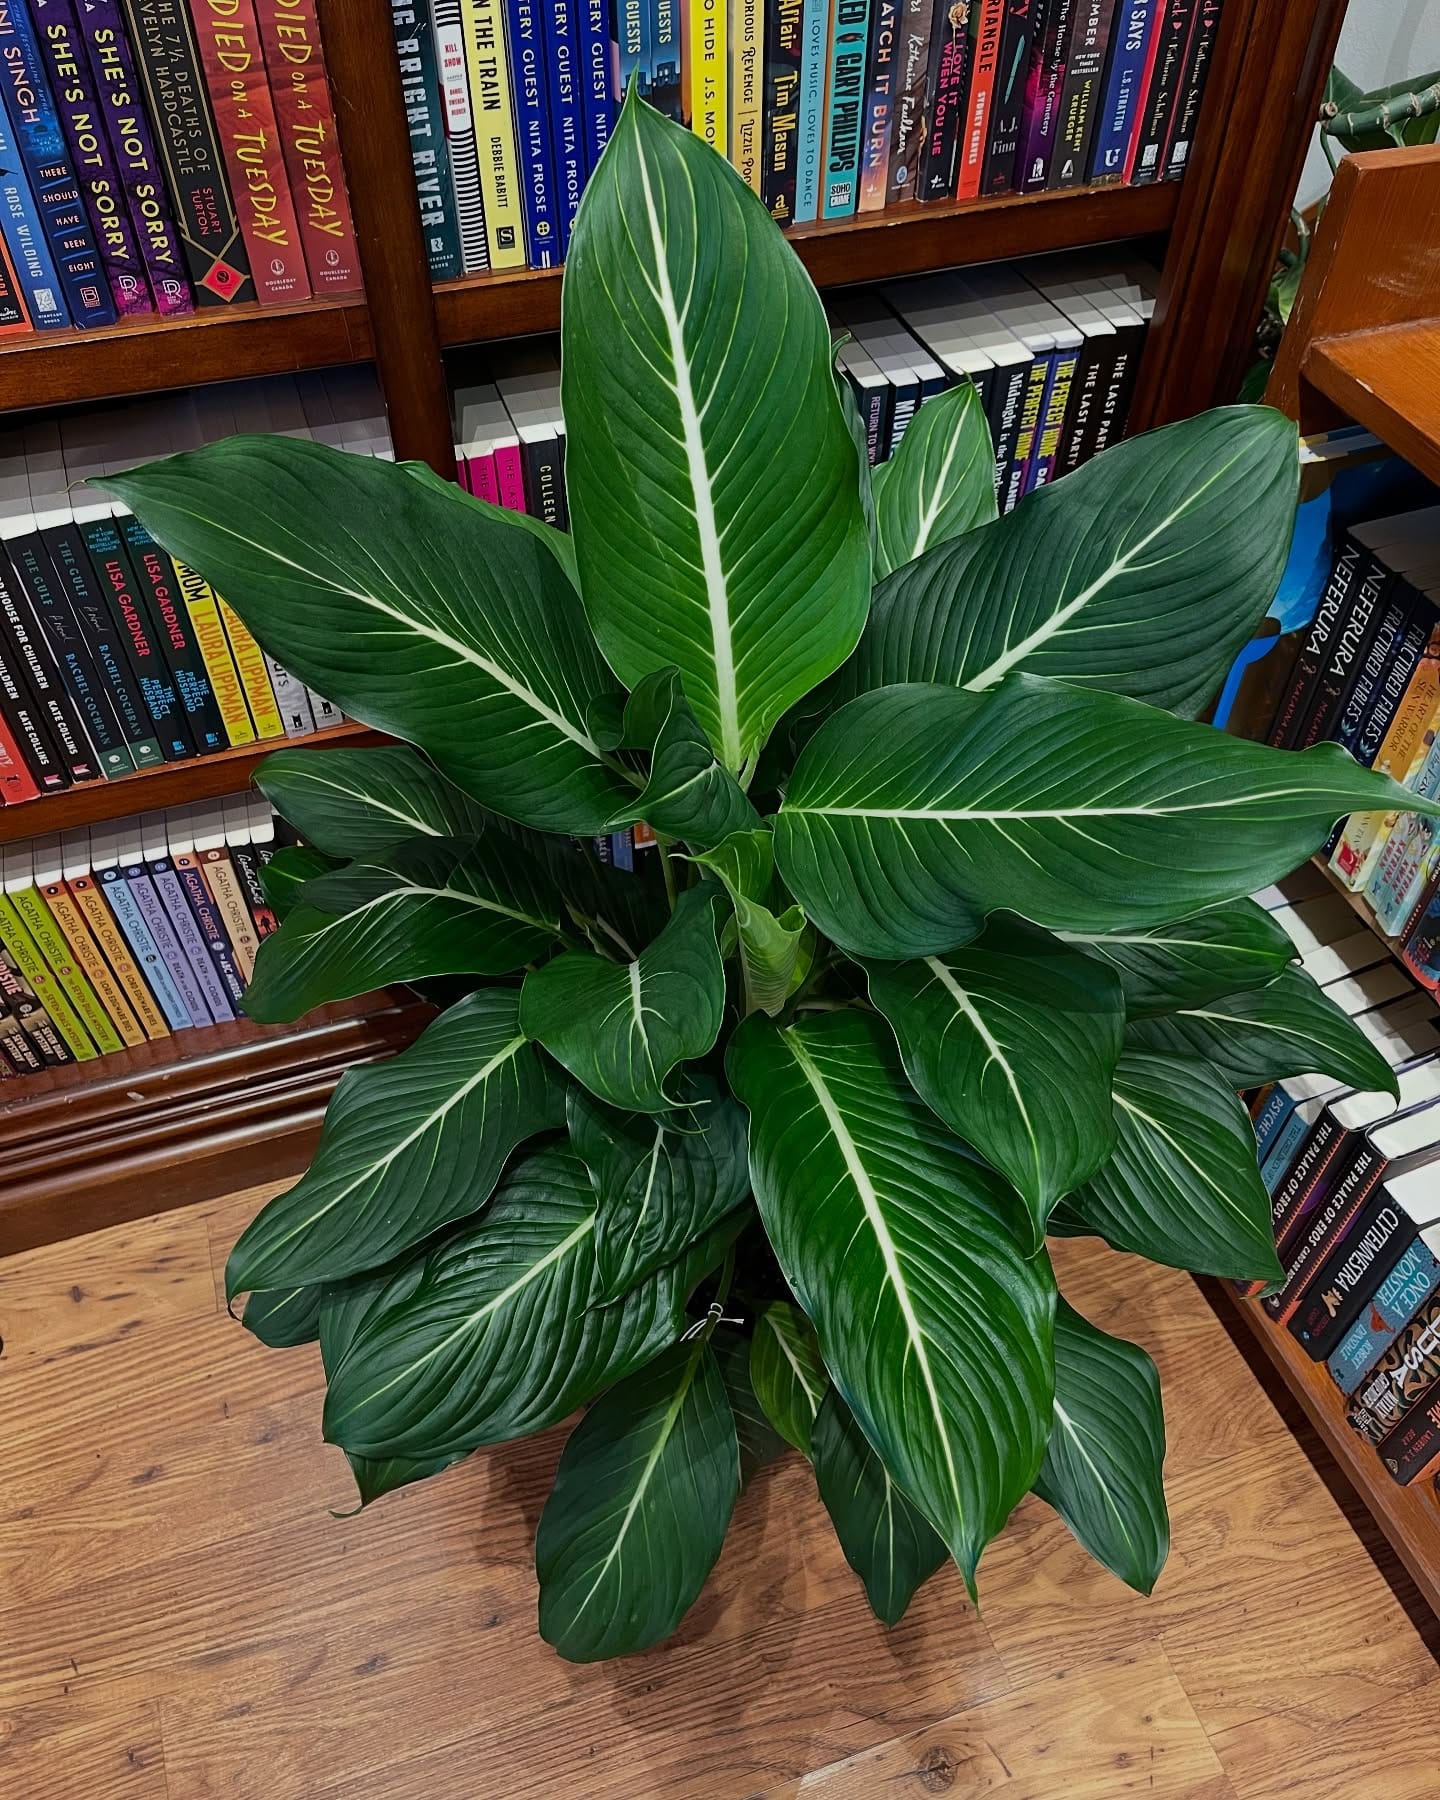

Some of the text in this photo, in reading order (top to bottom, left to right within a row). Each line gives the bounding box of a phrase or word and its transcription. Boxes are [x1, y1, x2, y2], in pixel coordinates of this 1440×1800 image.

[626, 0, 641, 54] GUESTS
[778, 0, 802, 49] Affair
[1060, 0, 1070, 21] The
[1125, 9, 1147, 51] SAYS
[444, 57, 462, 68] SHOW
[704, 18, 715, 105] HIDE J.S.
[905, 34, 925, 91] Katherine
[1054, 25, 1066, 57] House
[4, 46, 41, 123] SINGH
[397, 39, 432, 137] BRIGHT
[479, 57, 501, 111] TRAIN
[591, 42, 607, 150] GUEST NITA
[742, 47, 755, 103] REVENGE
[774, 71, 798, 107] Tim
[834, 53, 862, 101] GARY
[932, 42, 953, 156] WHEN YOU LIE
[949, 44, 964, 106] LOVE IT
[1049, 74, 1058, 89] the
[156, 66, 193, 175] HARDCASTLE
[175, 71, 201, 138] DEATHS
[207, 0, 289, 246] DIED ON A TUESDAY
[522, 49, 547, 213] GUEST NITA PROSE
[557, 45, 579, 209] GUEST NITA PROSE
[803, 19, 820, 207] LOVES LOVES TO DANCE
[869, 74, 889, 168] IT BURN
[897, 96, 915, 155] Faulkner
[1040, 90, 1056, 136] Cemetery
[1065, 95, 1079, 141] KRUEGER
[1073, 80, 1092, 152] WILLIAM KENT
[1112, 88, 1130, 132] STRATTON
[47, 24, 84, 103] SHE'S
[71, 113, 104, 167] NOT
[91, 180, 130, 260] SORRY
[95, 29, 131, 107] SHE'S
[118, 118, 148, 171] NOT
[136, 184, 174, 264] SORRY
[291, 72, 345, 237] ON A TUESDAY
[740, 119, 754, 154] LIZZIE
[772, 113, 796, 172] Mason
[829, 100, 859, 173] PHILLIPS
[991, 141, 1016, 156] Finn
[39, 167, 67, 178] THERE
[42, 191, 79, 203] SHOULD
[413, 149, 445, 227] RIVER
[491, 137, 509, 208] DEBBIE BABITT
[831, 183, 850, 194] SOHO
[4, 187, 43, 278] ROSE WILDING
[56, 215, 80, 226] HAVE
[190, 189, 209, 236] TURTON
[202, 187, 222, 234] STUART
[63, 239, 86, 249] BEEN
[68, 261, 95, 272] EIGHT
[868, 396, 880, 444] RETURN TO
[996, 373, 1024, 459] Midnight is the
[1104, 384, 1120, 414] LAST
[1038, 428, 1060, 459] HOME
[1067, 393, 1092, 466] LAST PARTY
[505, 457, 515, 479] THE
[540, 465, 556, 523] COLLEEN
[33, 574, 53, 607] GULF
[68, 564, 88, 597] GULF
[105, 560, 151, 657] LISA GARDNER
[143, 554, 186, 650] LISA GARDNER
[1305, 543, 1361, 656] NEFERURA
[177, 560, 241, 724] MOM LAURA LIPPMAN
[1330, 564, 1387, 678] NEFERURA
[0, 593, 78, 755] HOUSE FOR CHILDREN KATE COLLINS
[99, 644, 122, 685] RACHEL
[117, 688, 142, 736] COCHRAN
[185, 672, 205, 707] PERFECT
[198, 678, 209, 696] THE
[239, 652, 276, 717] LIPPMAN
[1346, 603, 1405, 722] FRACTURED FABLES
[1365, 623, 1427, 743] FRACTURED FABLES
[65, 653, 112, 746] RACHEL COCHRAN
[140, 678, 162, 720] HUSBAND
[150, 679, 171, 715] PERFECT
[163, 686, 176, 704] THE
[174, 670, 196, 712] HUSBAND
[1408, 684, 1437, 738] HEART OF
[17, 710, 50, 766] KATE COLLINS
[1388, 703, 1416, 752] WARRIOR
[161, 877, 198, 945] AGATHA CHRISTIE
[184, 872, 220, 941] AGATHA CHRISTIE
[213, 866, 247, 933] AGATHA CHRISTIE
[41, 1026, 57, 1043] SEVEN
[1260, 1095, 1284, 1136] PSYCHE
[1273, 1144, 1321, 1219] PALACE OF EROS
[1337, 1174, 1360, 1212] PALACE
[1309, 1223, 1329, 1247] EROS
[1326, 1210, 1338, 1226] OF
[1334, 1207, 1399, 1292] CLYTEMNESTRA
[1376, 1247, 1421, 1306] MONSTER
[1392, 1271, 1431, 1318] ONCE A
[1351, 1339, 1374, 1370] ROBERT
